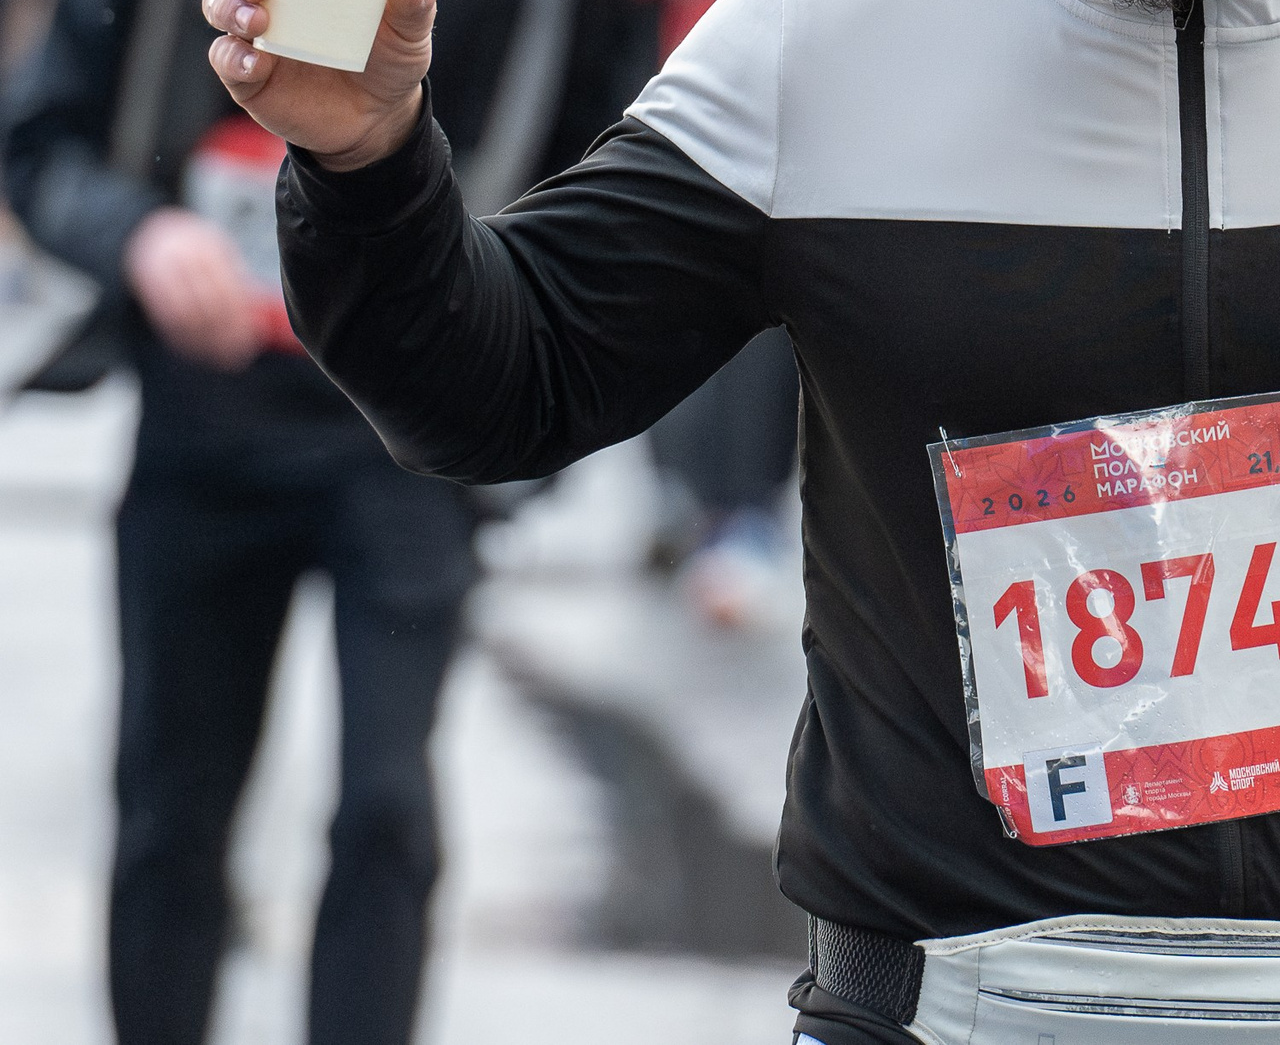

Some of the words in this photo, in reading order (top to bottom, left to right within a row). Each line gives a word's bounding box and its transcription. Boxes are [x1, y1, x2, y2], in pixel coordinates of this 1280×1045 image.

[1096, 468, 1198, 498] МАРАФОН
[1229, 759, 1280, 779] МОСКОВСКИЙ
[1045, 755, 1087, 821] F
[1231, 776, 1255, 791] СПОРТ
